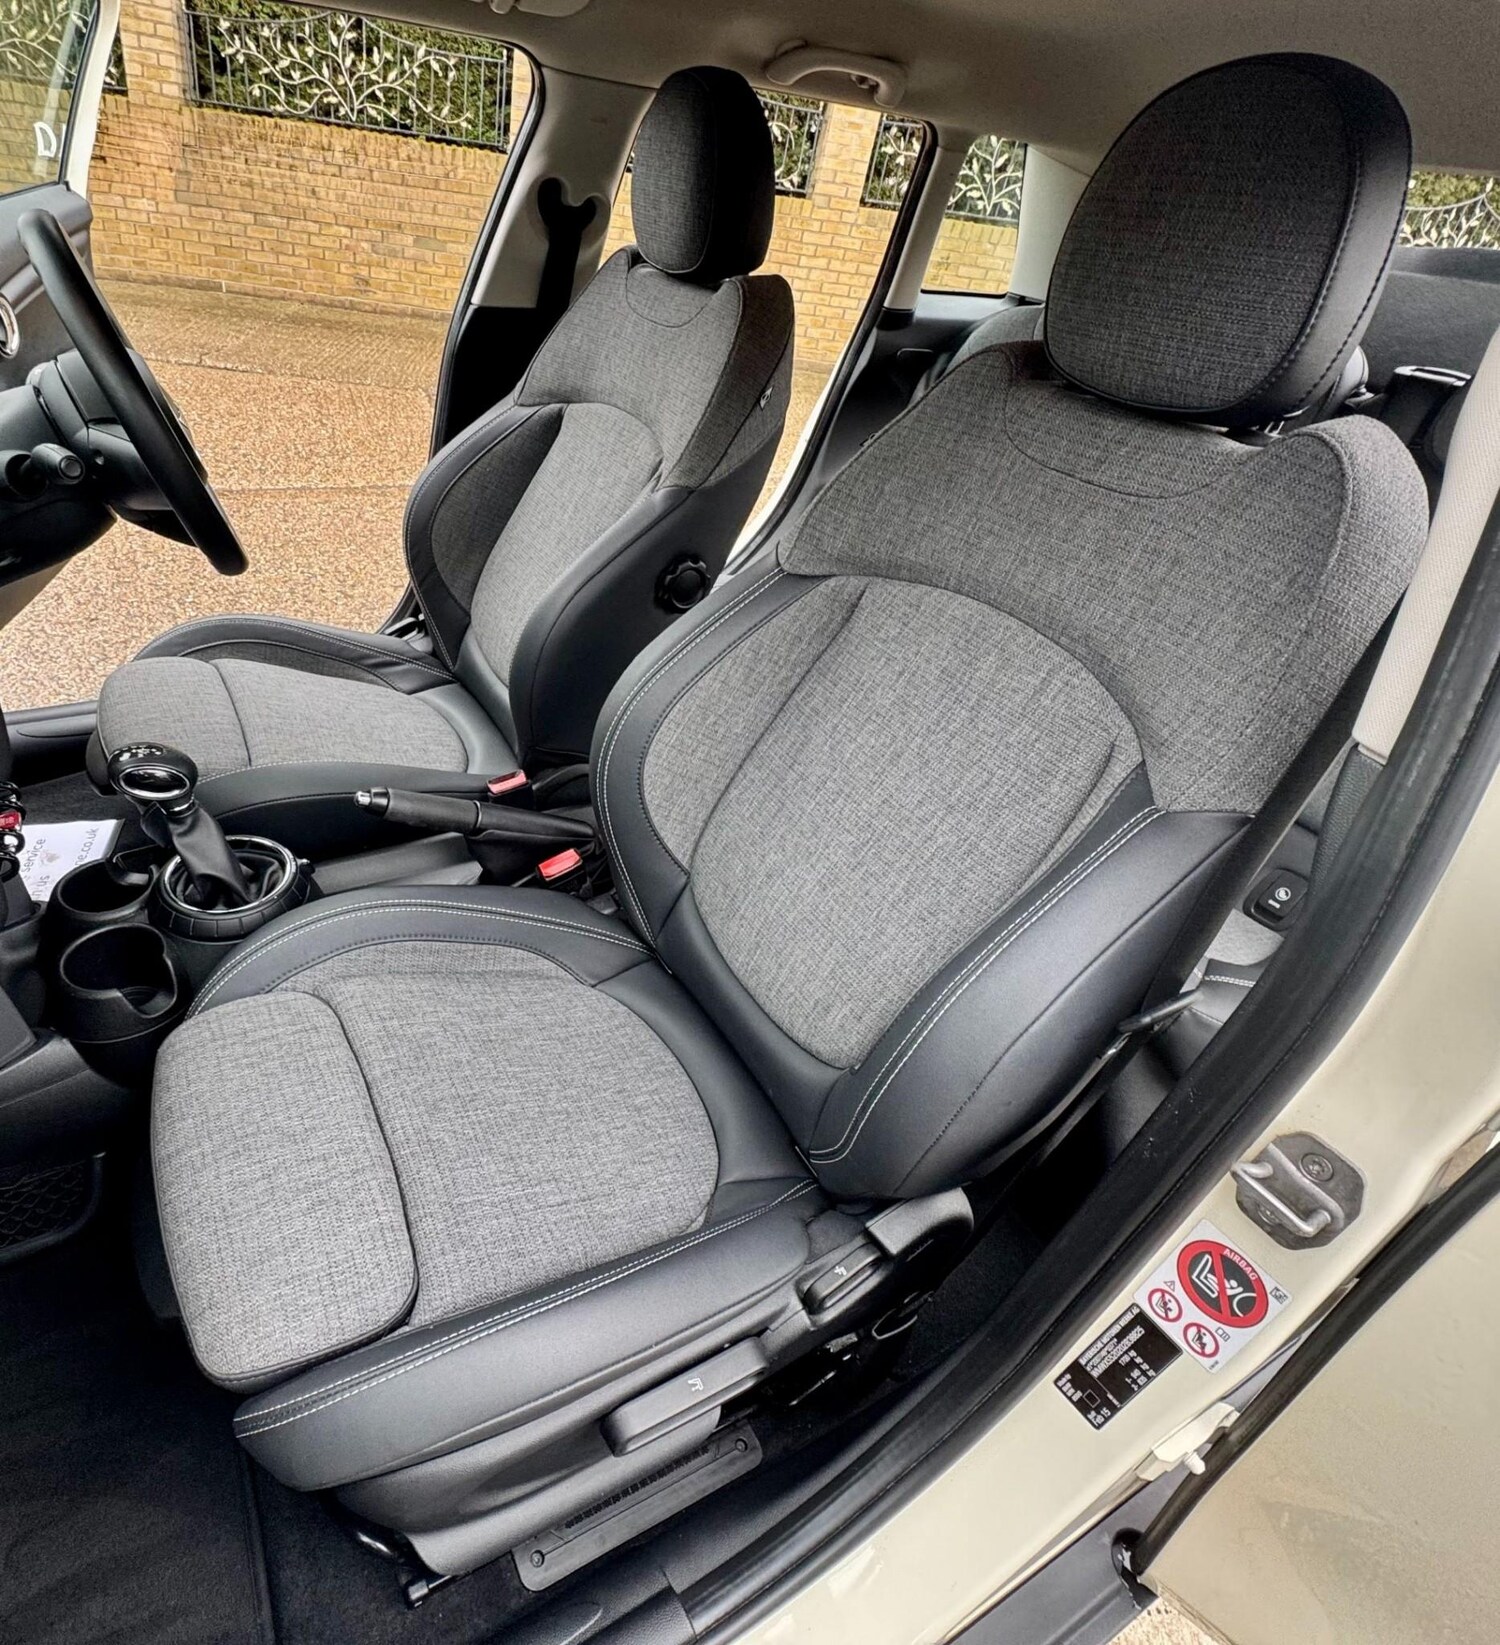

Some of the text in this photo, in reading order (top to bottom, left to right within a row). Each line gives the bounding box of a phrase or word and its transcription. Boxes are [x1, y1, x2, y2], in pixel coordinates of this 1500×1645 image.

[21, 839, 46, 873] service
[1222, 1248, 1259, 1281] AIRBAG
[1098, 1405, 1112, 1418] 15
